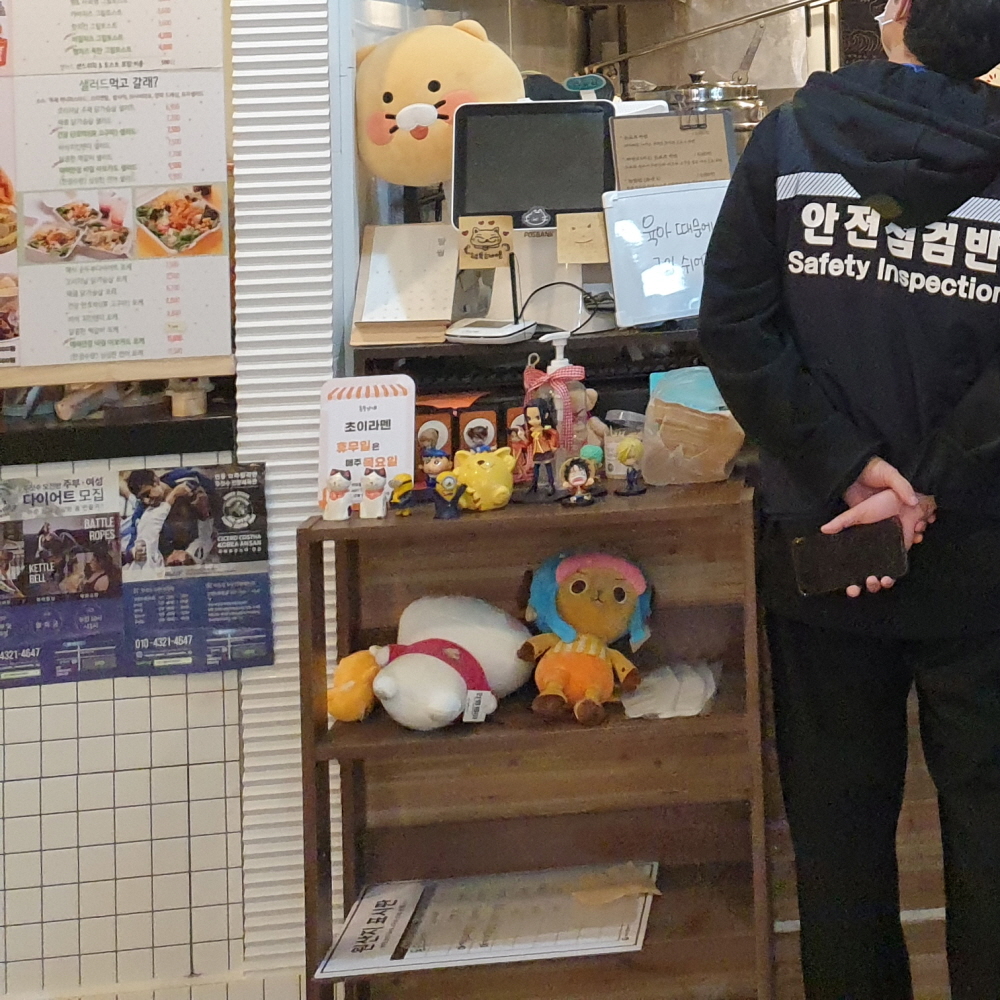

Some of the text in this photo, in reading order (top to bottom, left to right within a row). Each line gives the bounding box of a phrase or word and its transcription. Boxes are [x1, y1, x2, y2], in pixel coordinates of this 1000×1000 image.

[132, 75, 159, 89] 갈래?
[643, 215, 671, 246] 육아
[788, 250, 870, 281] Safety
[344, 419, 392, 432] 초이라멘
[23, 487, 104, 507] 다이어트 모집
[84, 516, 115, 530] BATTLE
[89, 529, 116, 542] ROPES
[29, 562, 55, 573] KETTLE
[29, 573, 46, 584] BELL
